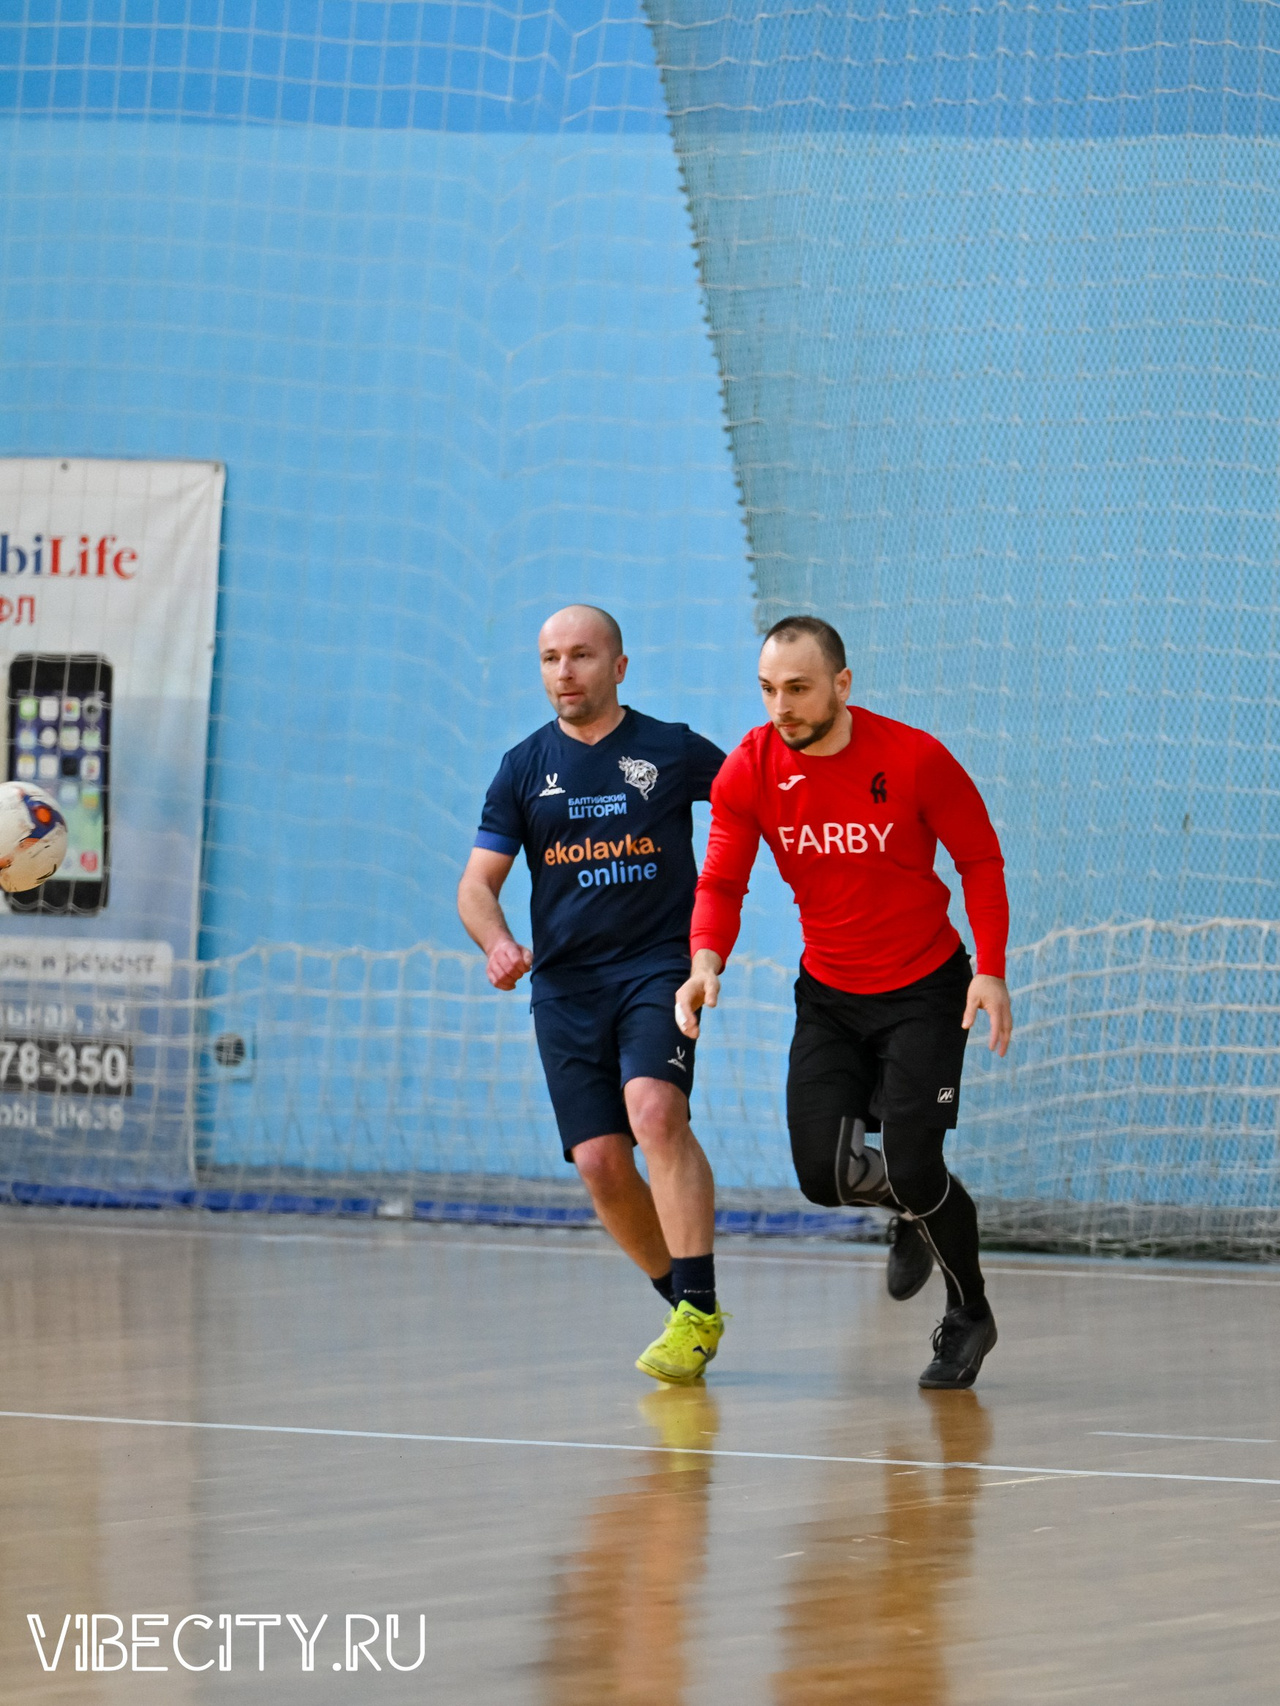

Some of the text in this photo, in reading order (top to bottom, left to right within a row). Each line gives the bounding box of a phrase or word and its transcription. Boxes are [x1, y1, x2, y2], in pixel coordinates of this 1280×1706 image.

[568, 792, 627, 806] БАЛТИЙСКИЙ
[568, 801, 628, 820] ШТОРМ
[544, 834, 662, 866] ekolavka.
[778, 822, 895, 855] FARBY
[577, 860, 658, 888] online
